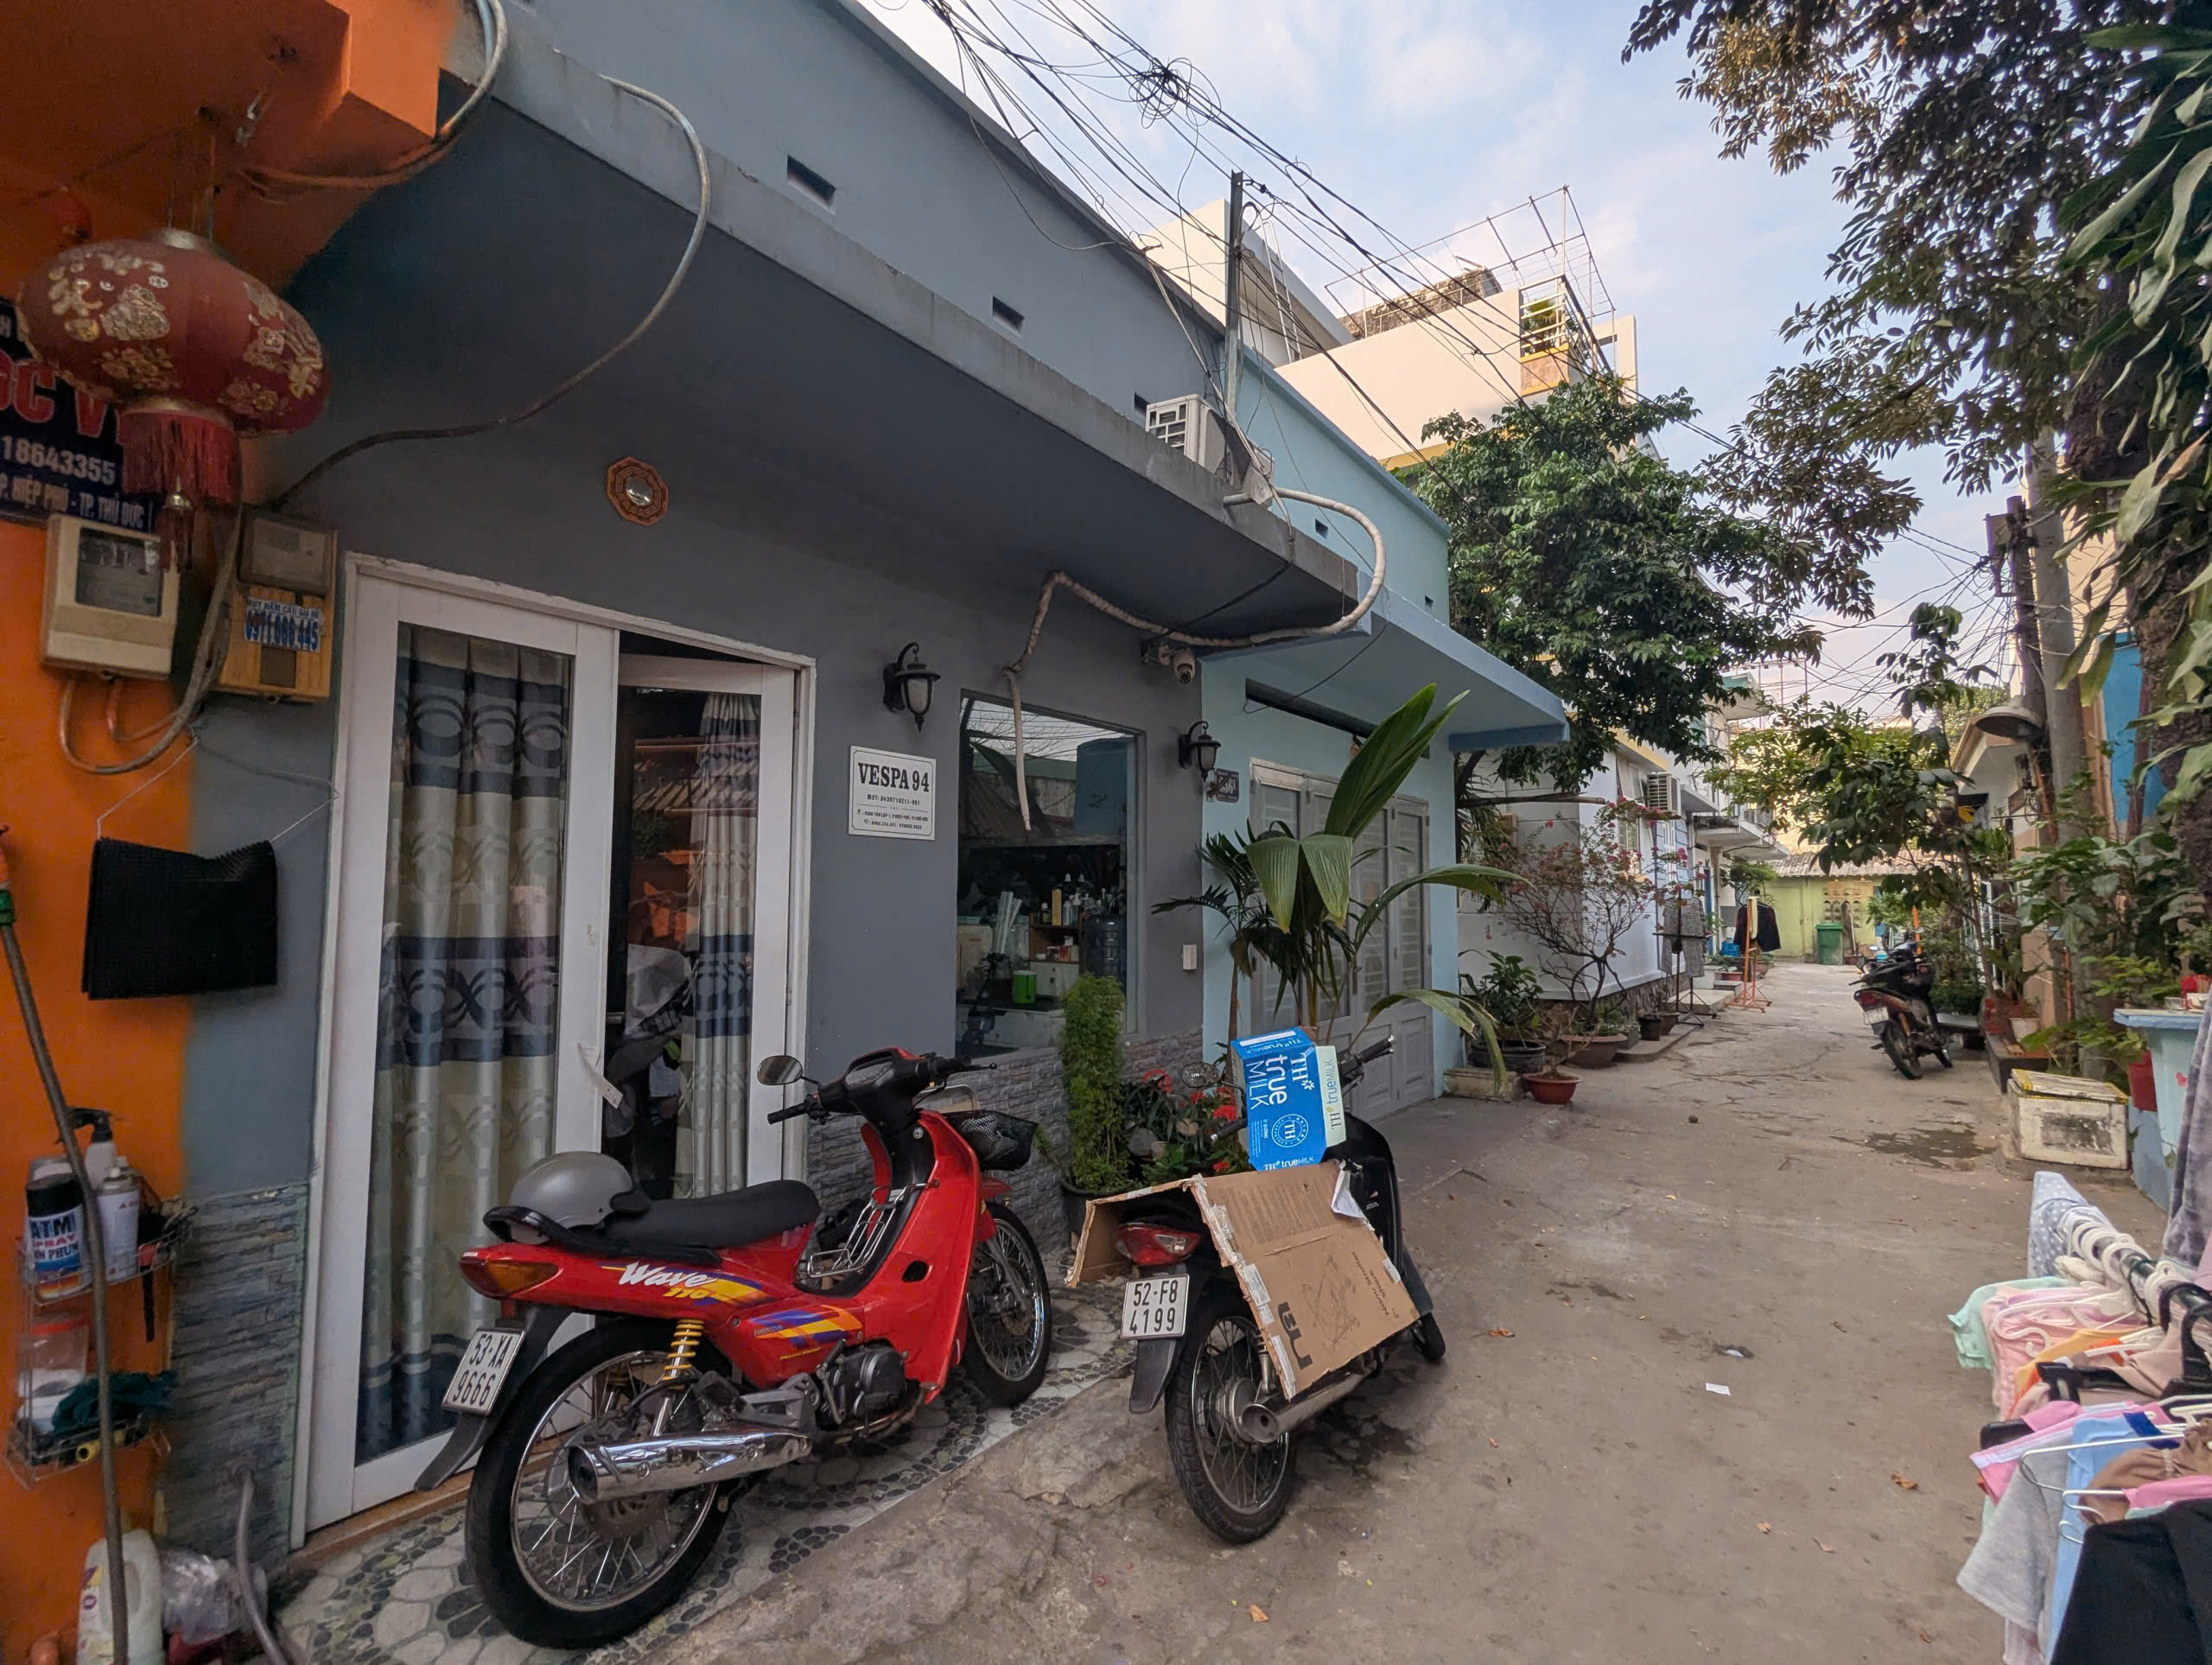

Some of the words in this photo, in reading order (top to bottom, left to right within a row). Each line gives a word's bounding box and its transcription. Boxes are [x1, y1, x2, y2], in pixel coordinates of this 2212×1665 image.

[858, 762, 909, 790] VESPA
[912, 770, 929, 792] 94
[1265, 1054, 1288, 1105] true
[1291, 1052, 1309, 1082] TH
[1246, 1060, 1269, 1110] MILK
[1285, 1121, 1296, 1140] TH
[1330, 1112, 1342, 1130] TH
[619, 1261, 718, 1287] Wave
[663, 1287, 709, 1300] 110
[1134, 1280, 1179, 1307] 52-F8
[753, 1324, 783, 1337] HONDA
[1129, 1307, 1176, 1334] 4199
[469, 1333, 513, 1369] 53-XA
[453, 1369, 496, 1407] 9666
